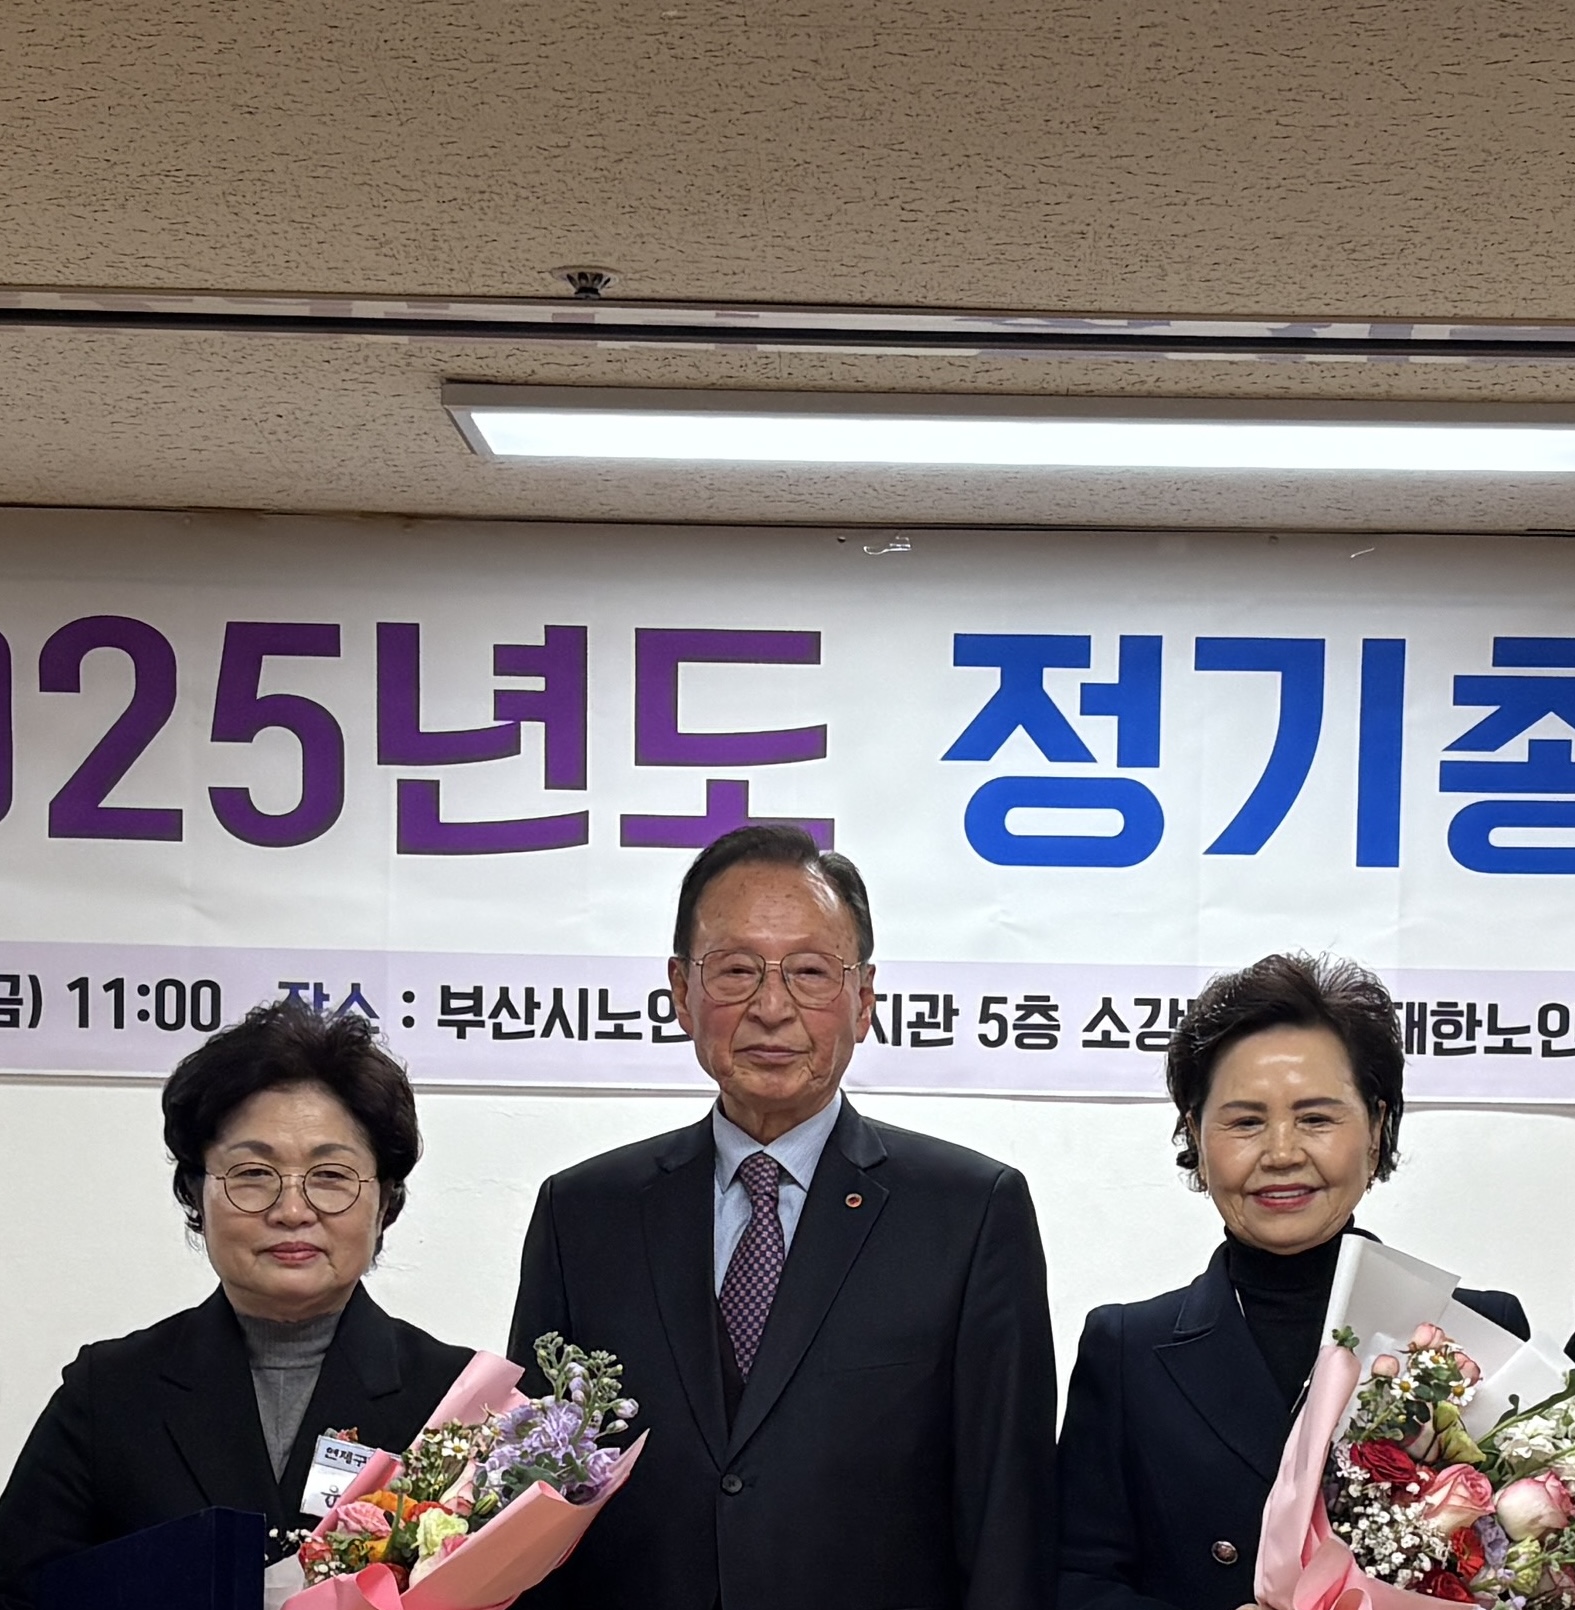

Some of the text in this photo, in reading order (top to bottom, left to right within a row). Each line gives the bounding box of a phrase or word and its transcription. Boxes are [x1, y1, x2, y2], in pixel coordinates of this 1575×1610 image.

[66, 976, 222, 1032] 11:00
[978, 995, 1061, 1049] 5층
[1081, 996, 1199, 1052] 소강
